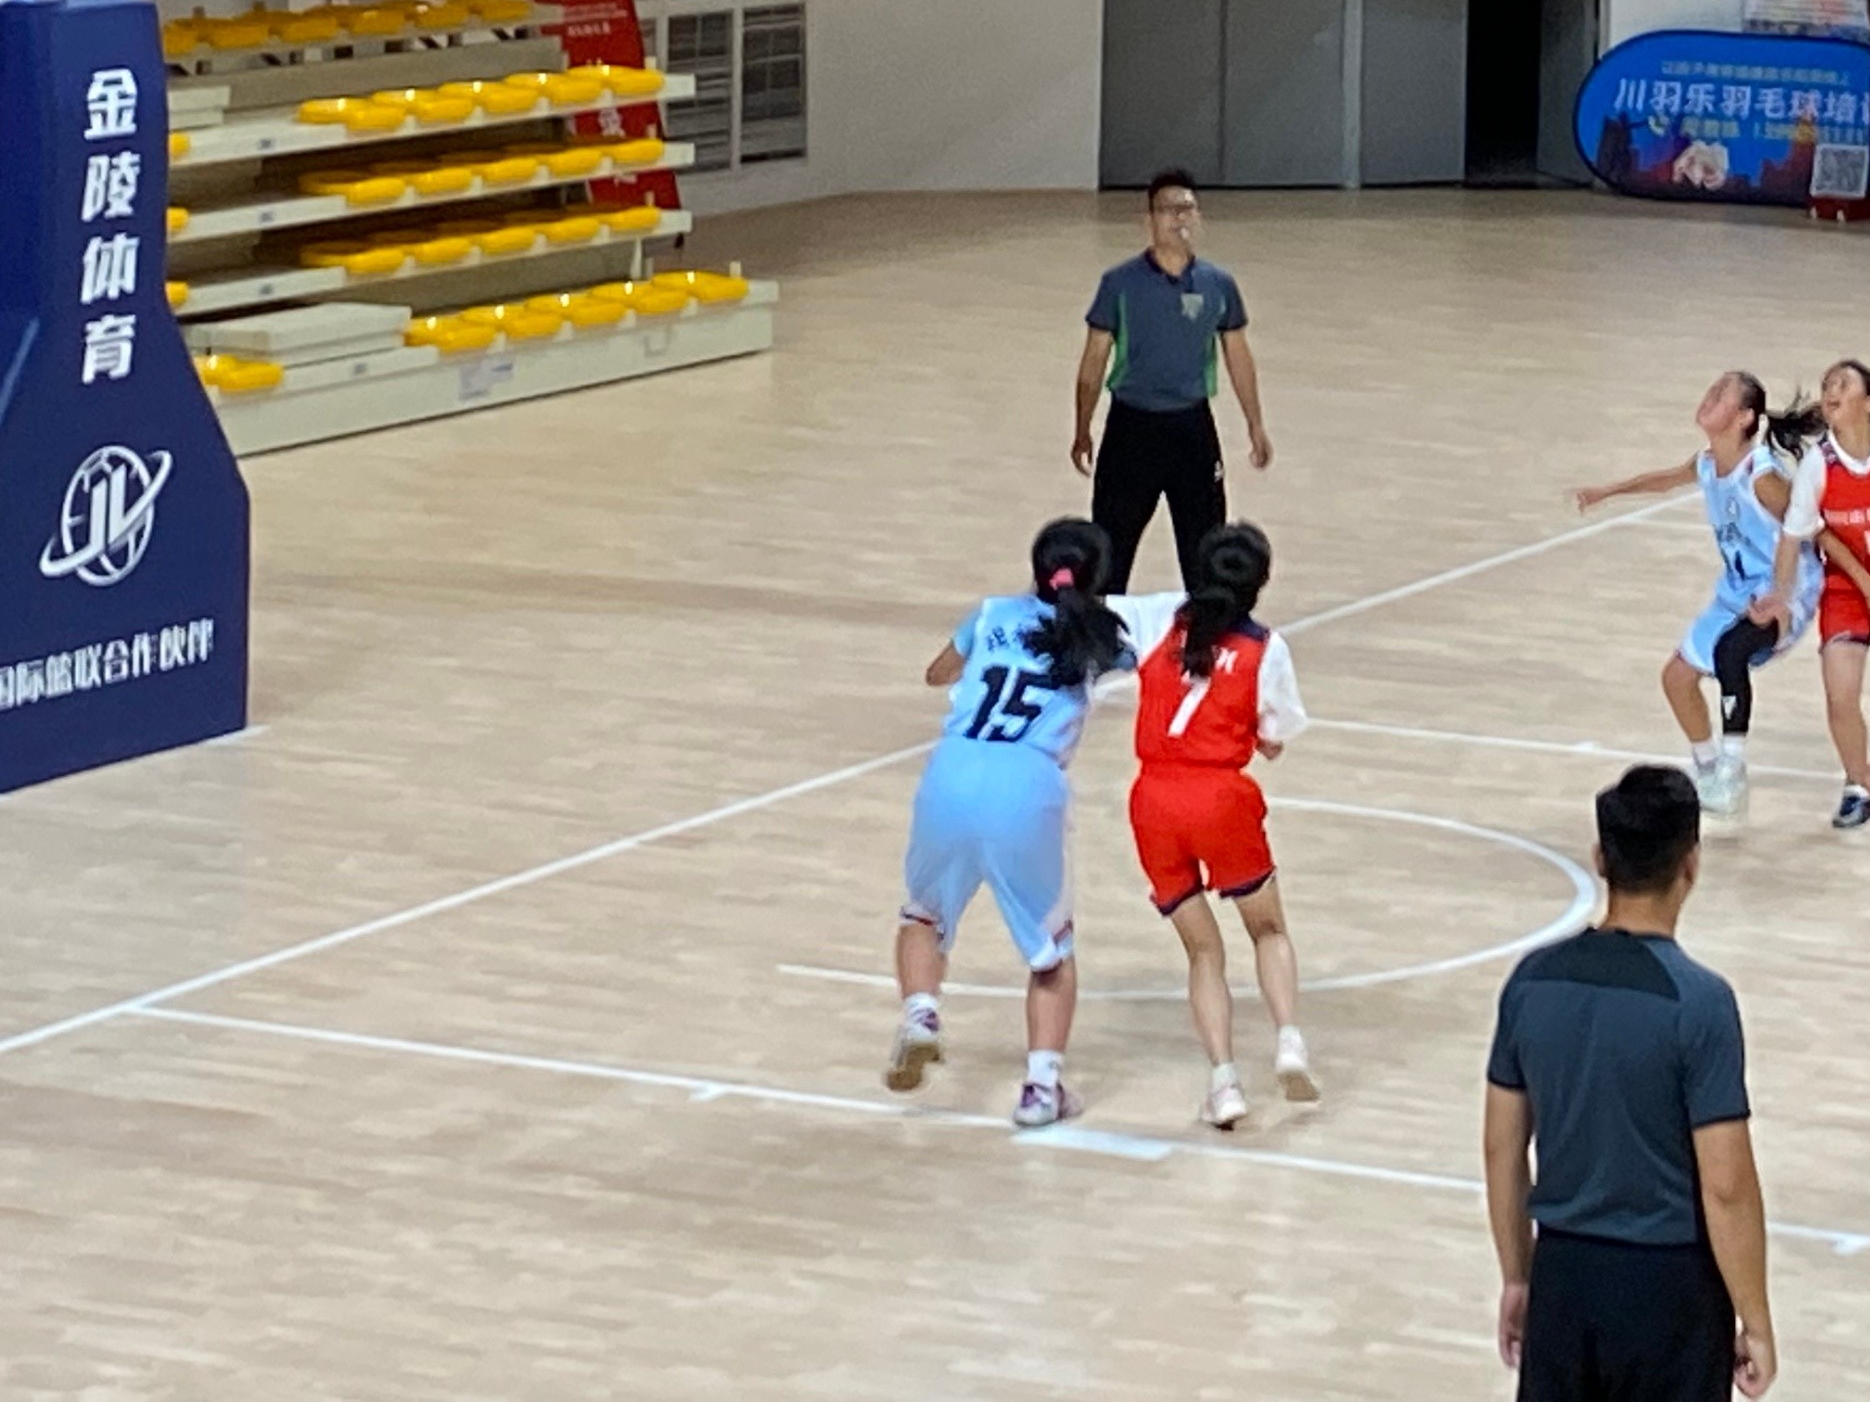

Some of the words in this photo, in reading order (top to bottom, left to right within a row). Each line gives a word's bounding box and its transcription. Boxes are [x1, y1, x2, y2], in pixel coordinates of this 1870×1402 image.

[80, 68, 141, 384] 金陵体育
[963, 665, 1060, 743] 15
